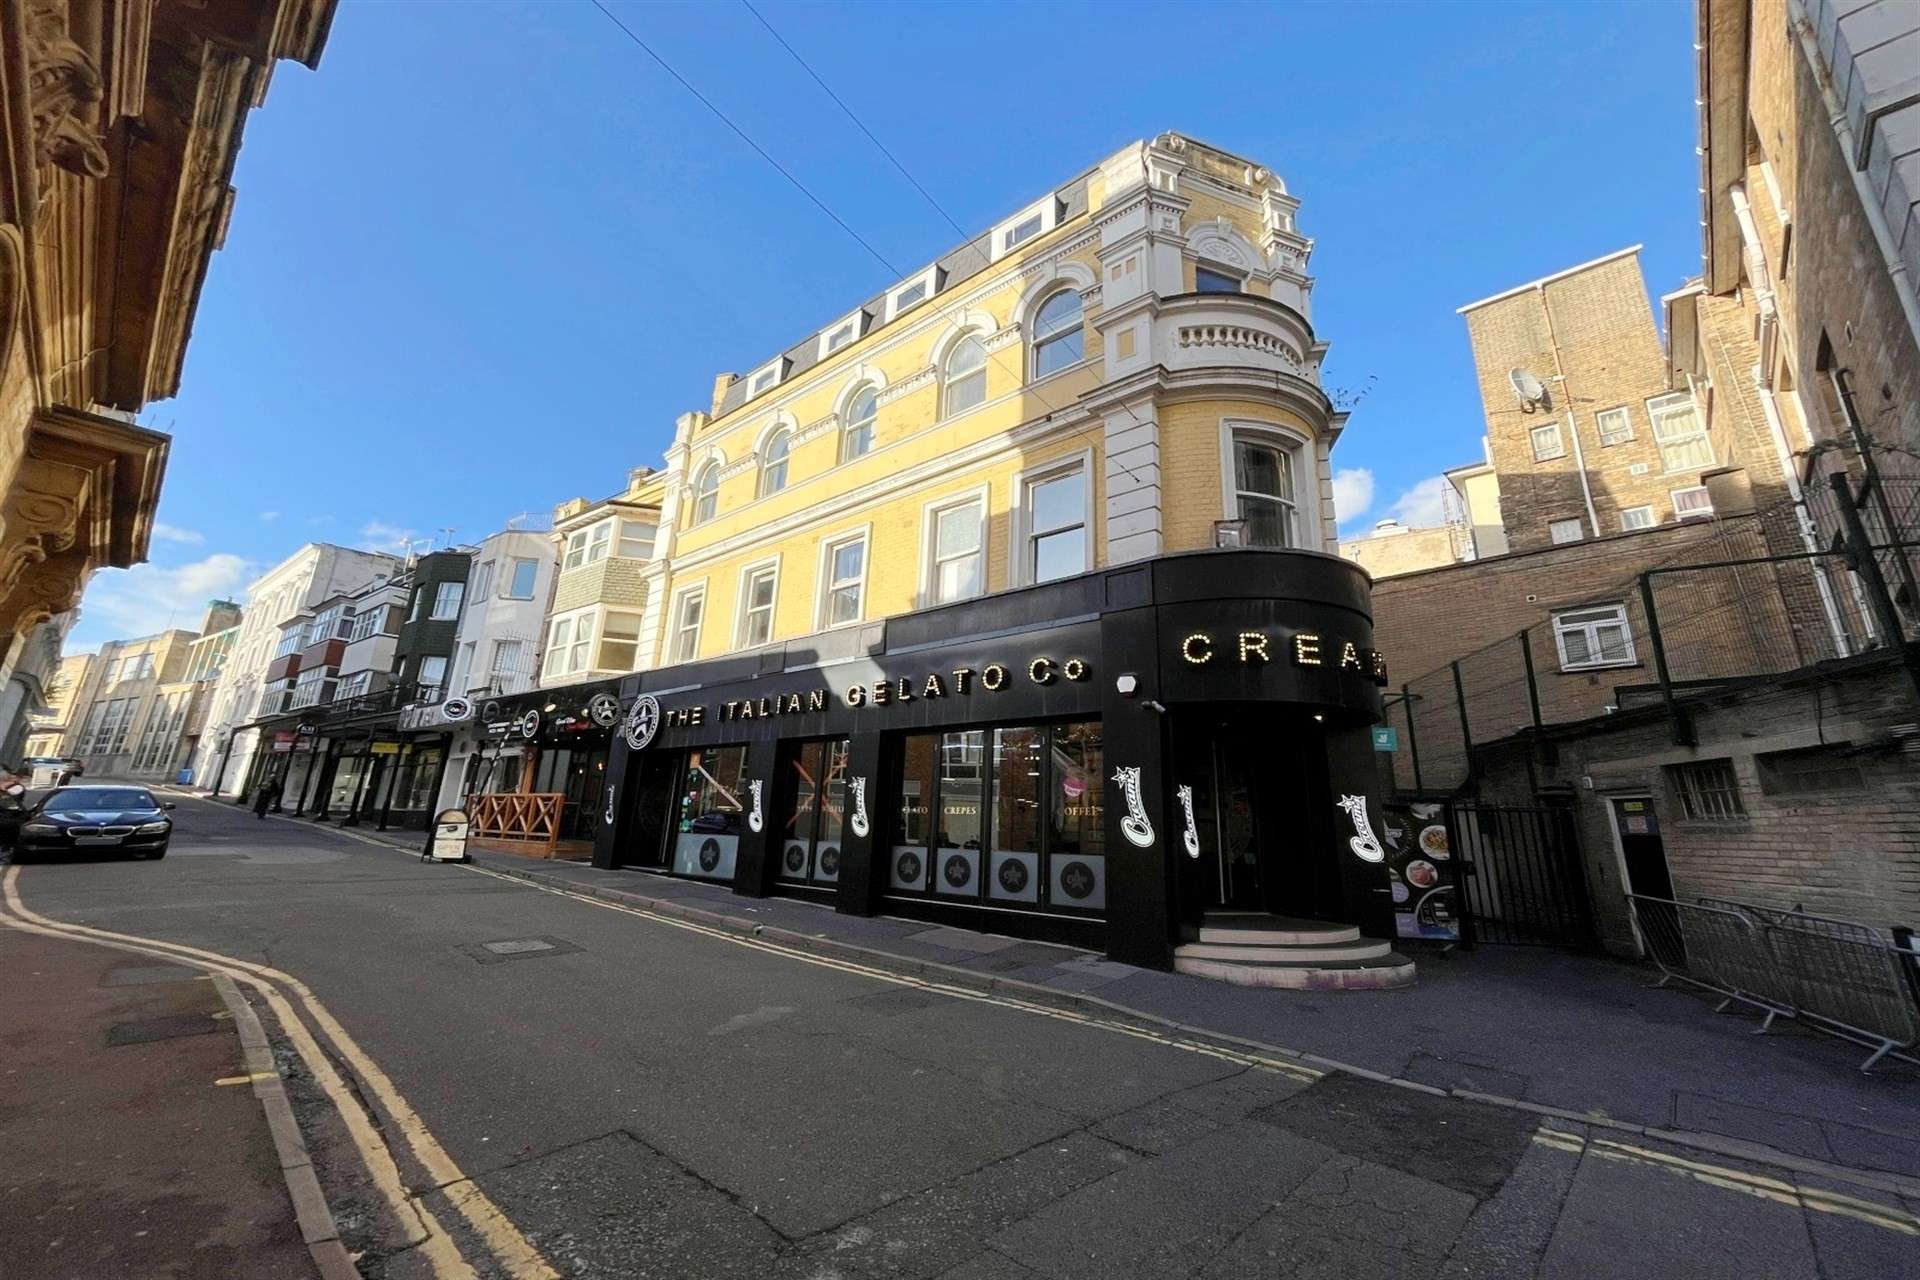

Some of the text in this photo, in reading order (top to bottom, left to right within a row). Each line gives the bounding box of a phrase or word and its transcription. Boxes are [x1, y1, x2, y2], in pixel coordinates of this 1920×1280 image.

[665, 706, 703, 728] THE
[716, 689, 826, 721] ITALIAN
[845, 664, 1004, 707] GELATO
[943, 805, 977, 815] CREPES
[1120, 766, 1156, 848] Creams
